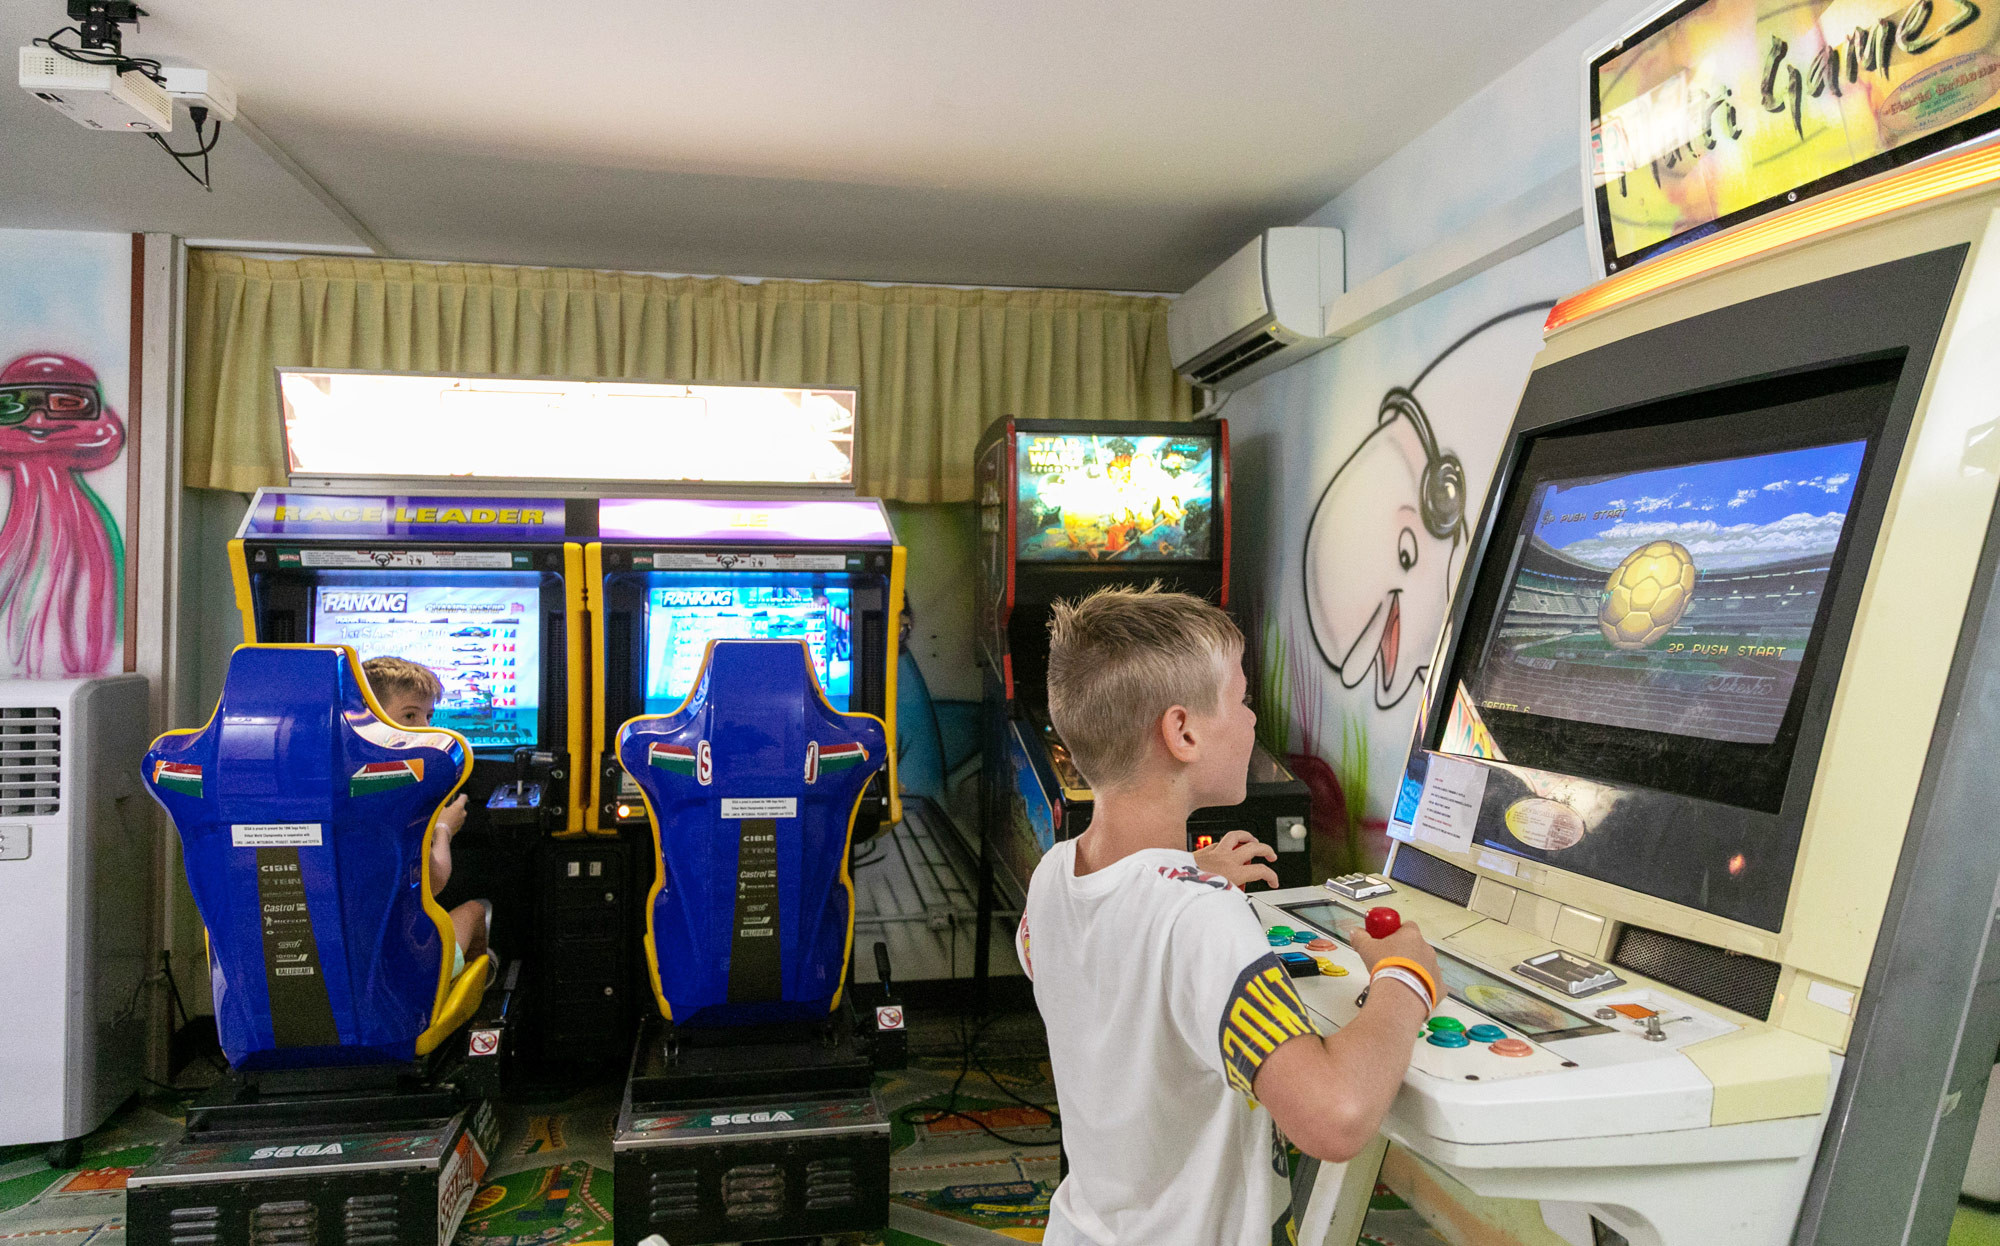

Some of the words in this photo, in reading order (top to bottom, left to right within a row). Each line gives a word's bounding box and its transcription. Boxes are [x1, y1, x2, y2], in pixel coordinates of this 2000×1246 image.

[275, 506, 384, 523] RACE
[394, 508, 546, 524] LEADER
[1560, 513, 1587, 523] PUSH
[1593, 508, 1629, 520] START
[324, 593, 407, 612] RANKING
[664, 590, 732, 606] RANKING
[1667, 643, 1685, 653] 2P
[1692, 644, 1729, 655] PUSH
[1737, 646, 1786, 657] START
[740, 870, 767, 879] Castrol
[263, 904, 295, 912] Castrol
[711, 1111, 794, 1126] SEGA
[249, 1143, 343, 1160] SEGA
